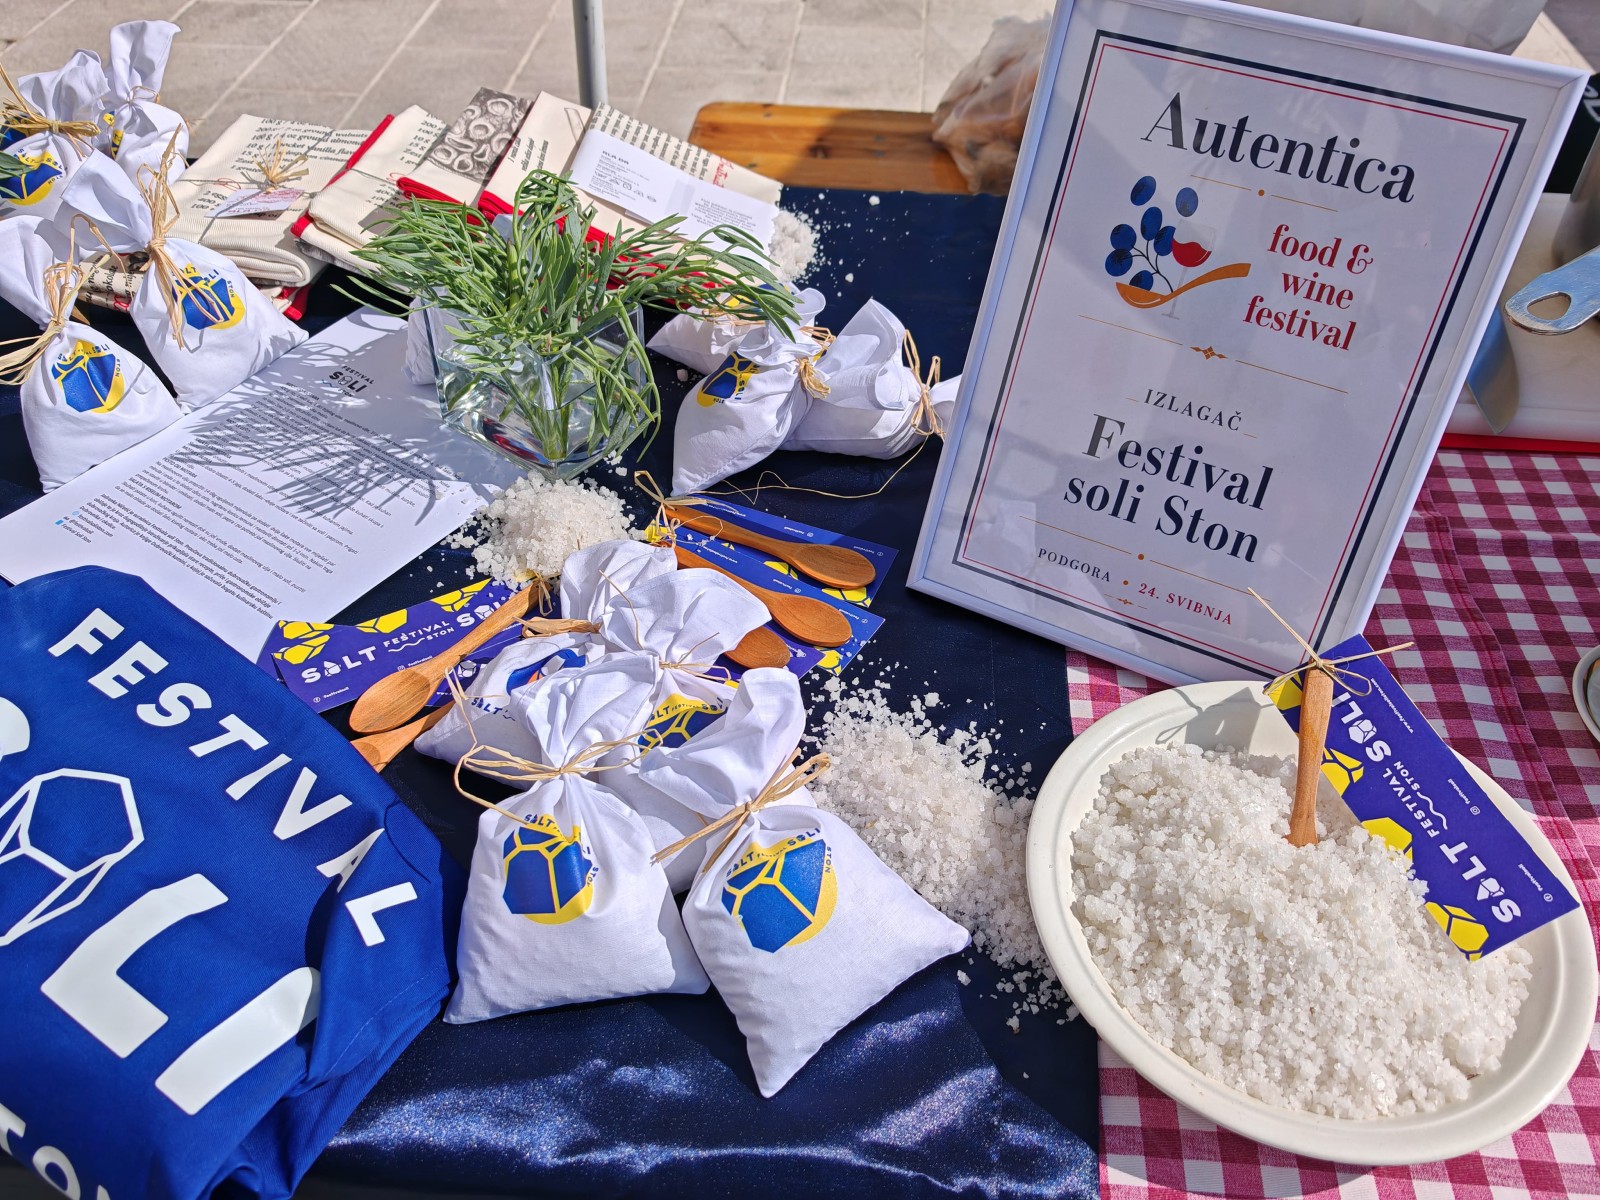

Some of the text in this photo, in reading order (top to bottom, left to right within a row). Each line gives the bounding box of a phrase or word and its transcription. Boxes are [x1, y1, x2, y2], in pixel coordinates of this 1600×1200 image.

[1140, 92, 1416, 204] Autentica
[1267, 223, 1374, 275] food &
[1281, 271, 1354, 310] wine
[1242, 294, 1358, 352] festival
[1143, 388, 1243, 432] IZLAGAČ
[1082, 413, 1274, 511] Festival
[1064, 476, 1259, 563] soli Ston
[1037, 547, 1112, 583] PODGORA
[1138, 582, 1233, 626] 24. SVIBNJA
[426, 627, 455, 641] STON
[48, 607, 418, 948] FESTIVAL
[1393, 760, 1421, 791] STON
[1382, 767, 1441, 839] FESTIVAL
